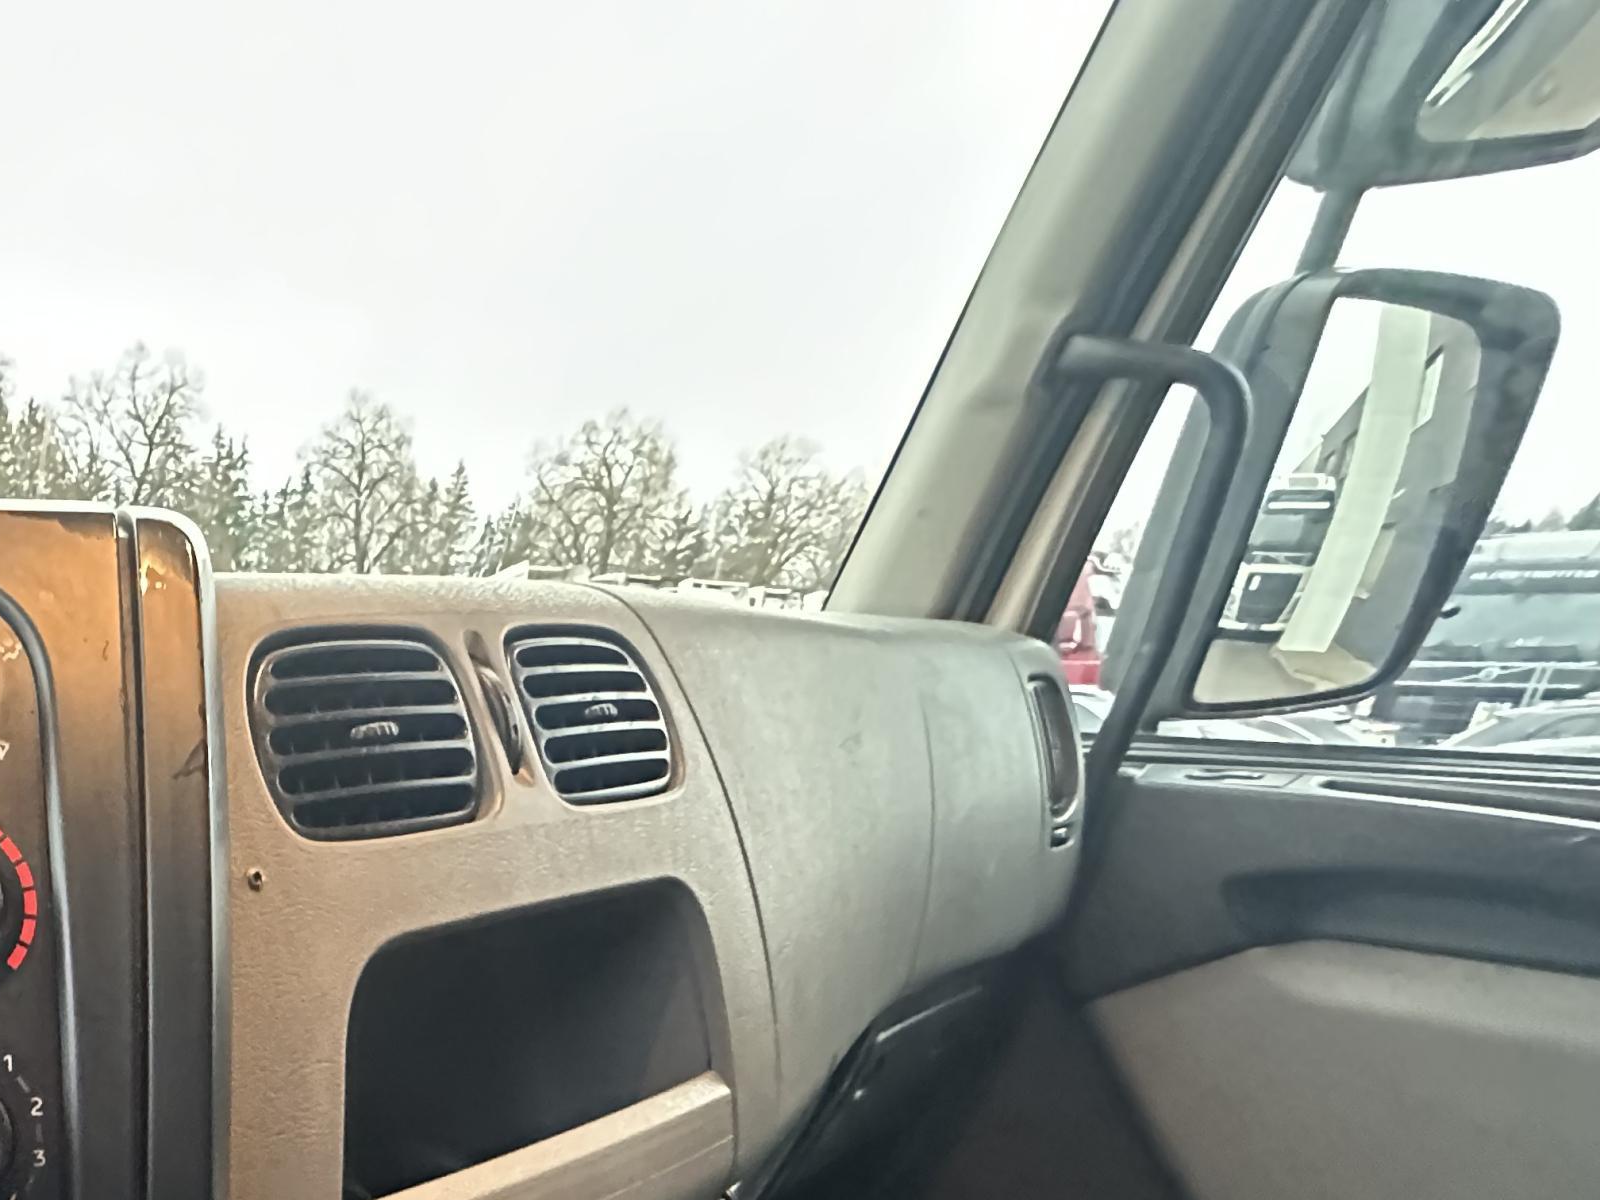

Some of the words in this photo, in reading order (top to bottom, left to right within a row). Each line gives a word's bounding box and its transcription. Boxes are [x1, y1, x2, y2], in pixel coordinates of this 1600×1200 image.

[2, 1054, 13, 1072] 1
[30, 1097, 43, 1116] 2
[34, 1150, 46, 1167] 3
